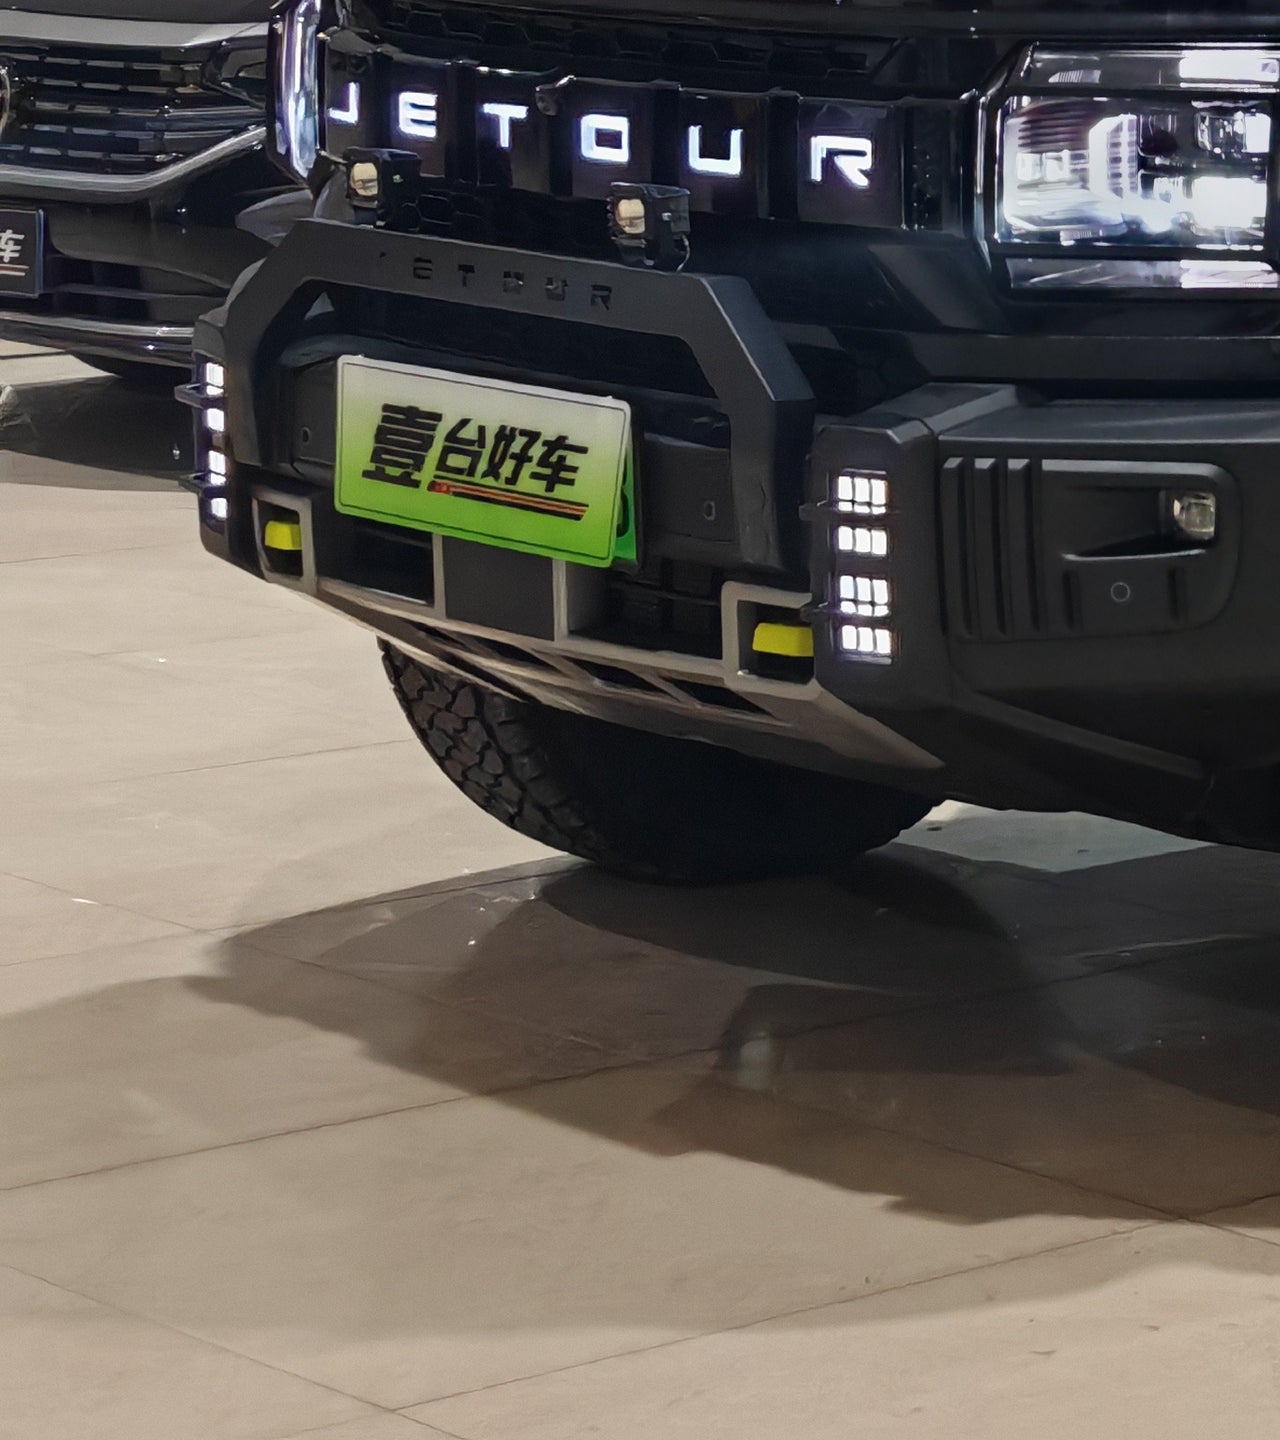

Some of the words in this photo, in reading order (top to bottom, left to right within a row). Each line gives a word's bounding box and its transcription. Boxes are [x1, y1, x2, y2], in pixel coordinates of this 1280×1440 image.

[327, 80, 874, 189] JETOUR
[378, 250, 613, 311] ETOUR
[361, 402, 589, 493] 壹台好车
